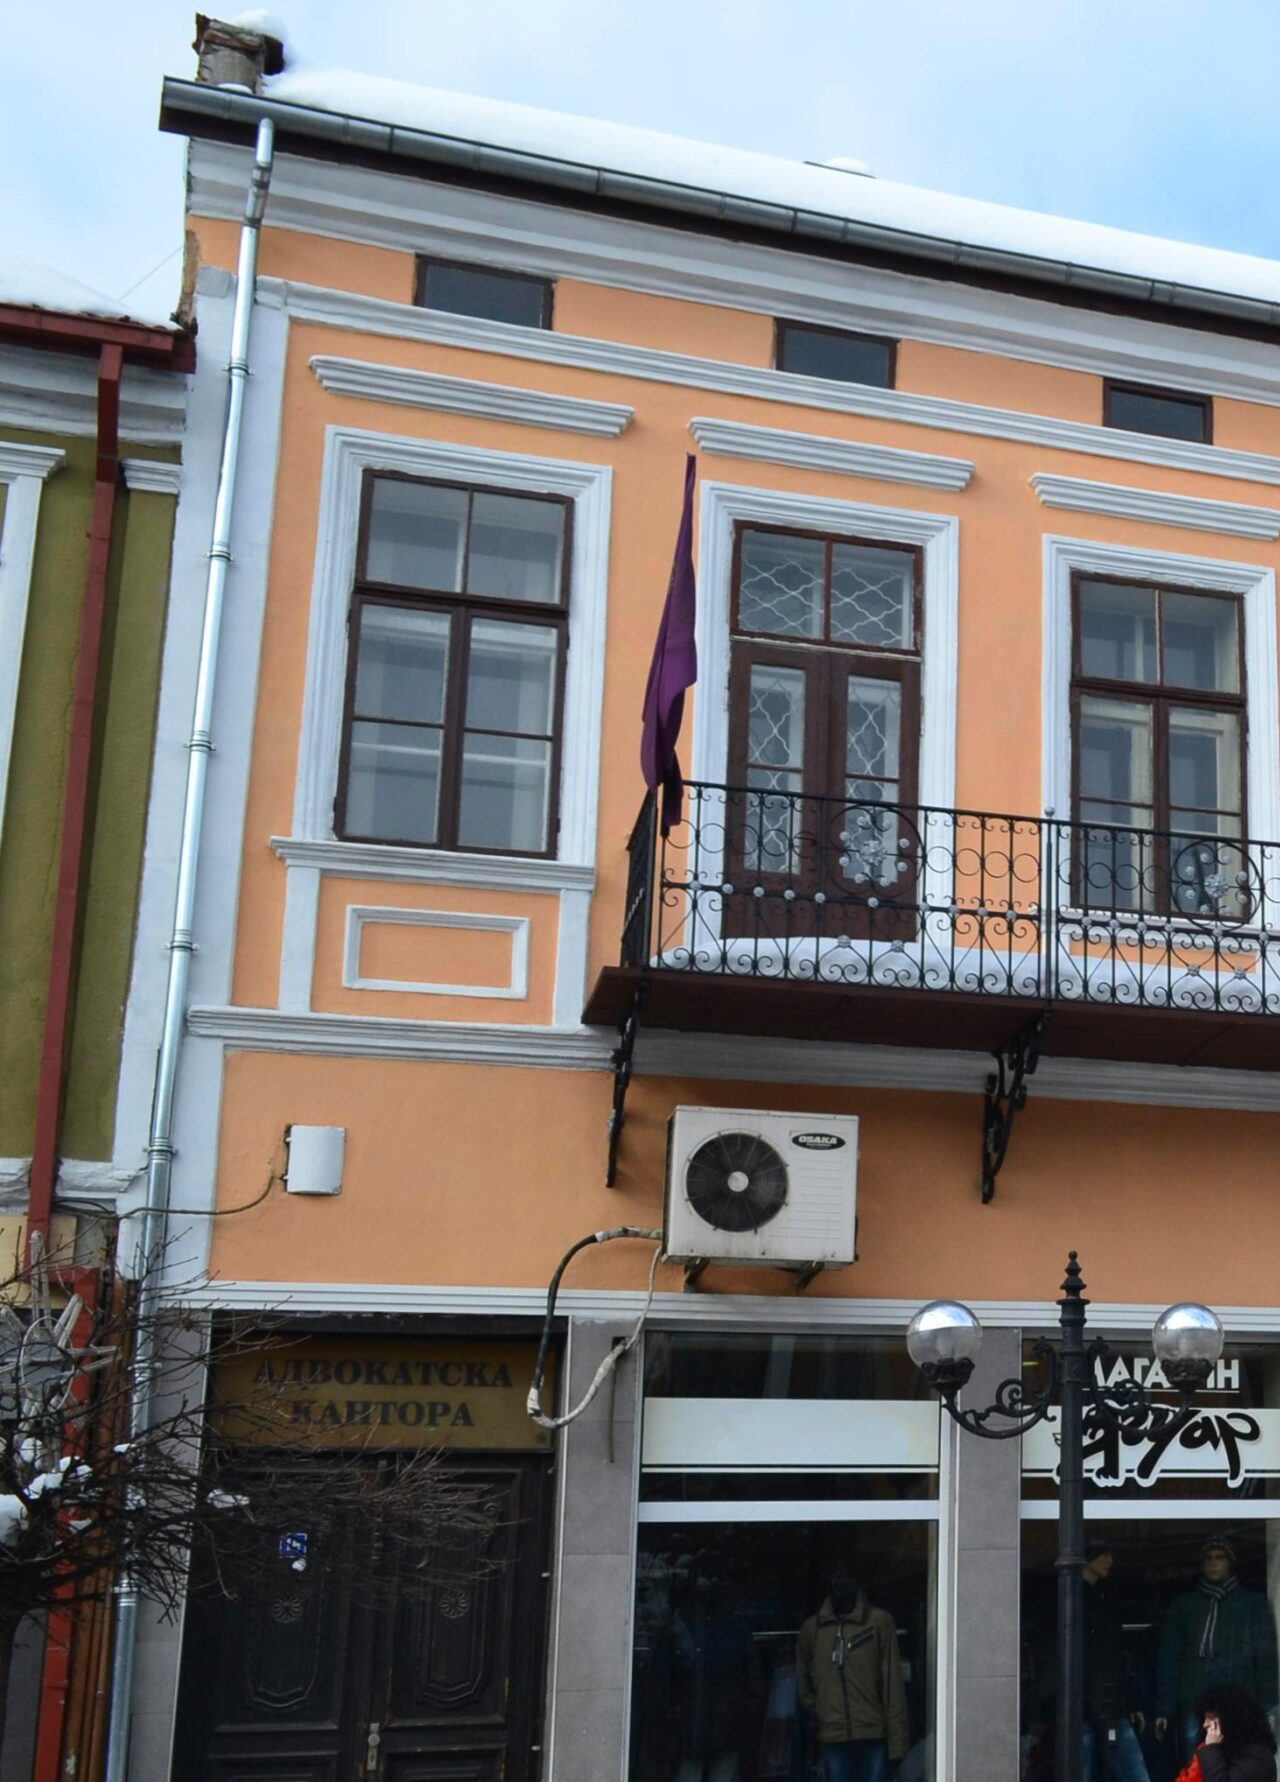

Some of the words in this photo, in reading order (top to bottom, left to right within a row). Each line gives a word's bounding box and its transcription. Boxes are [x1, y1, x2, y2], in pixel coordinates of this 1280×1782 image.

[798, 1135, 838, 1145] OSAKA
[255, 1358, 513, 1387] АДВОКАТСКА
[290, 1401, 475, 1427] КАНТОРА
